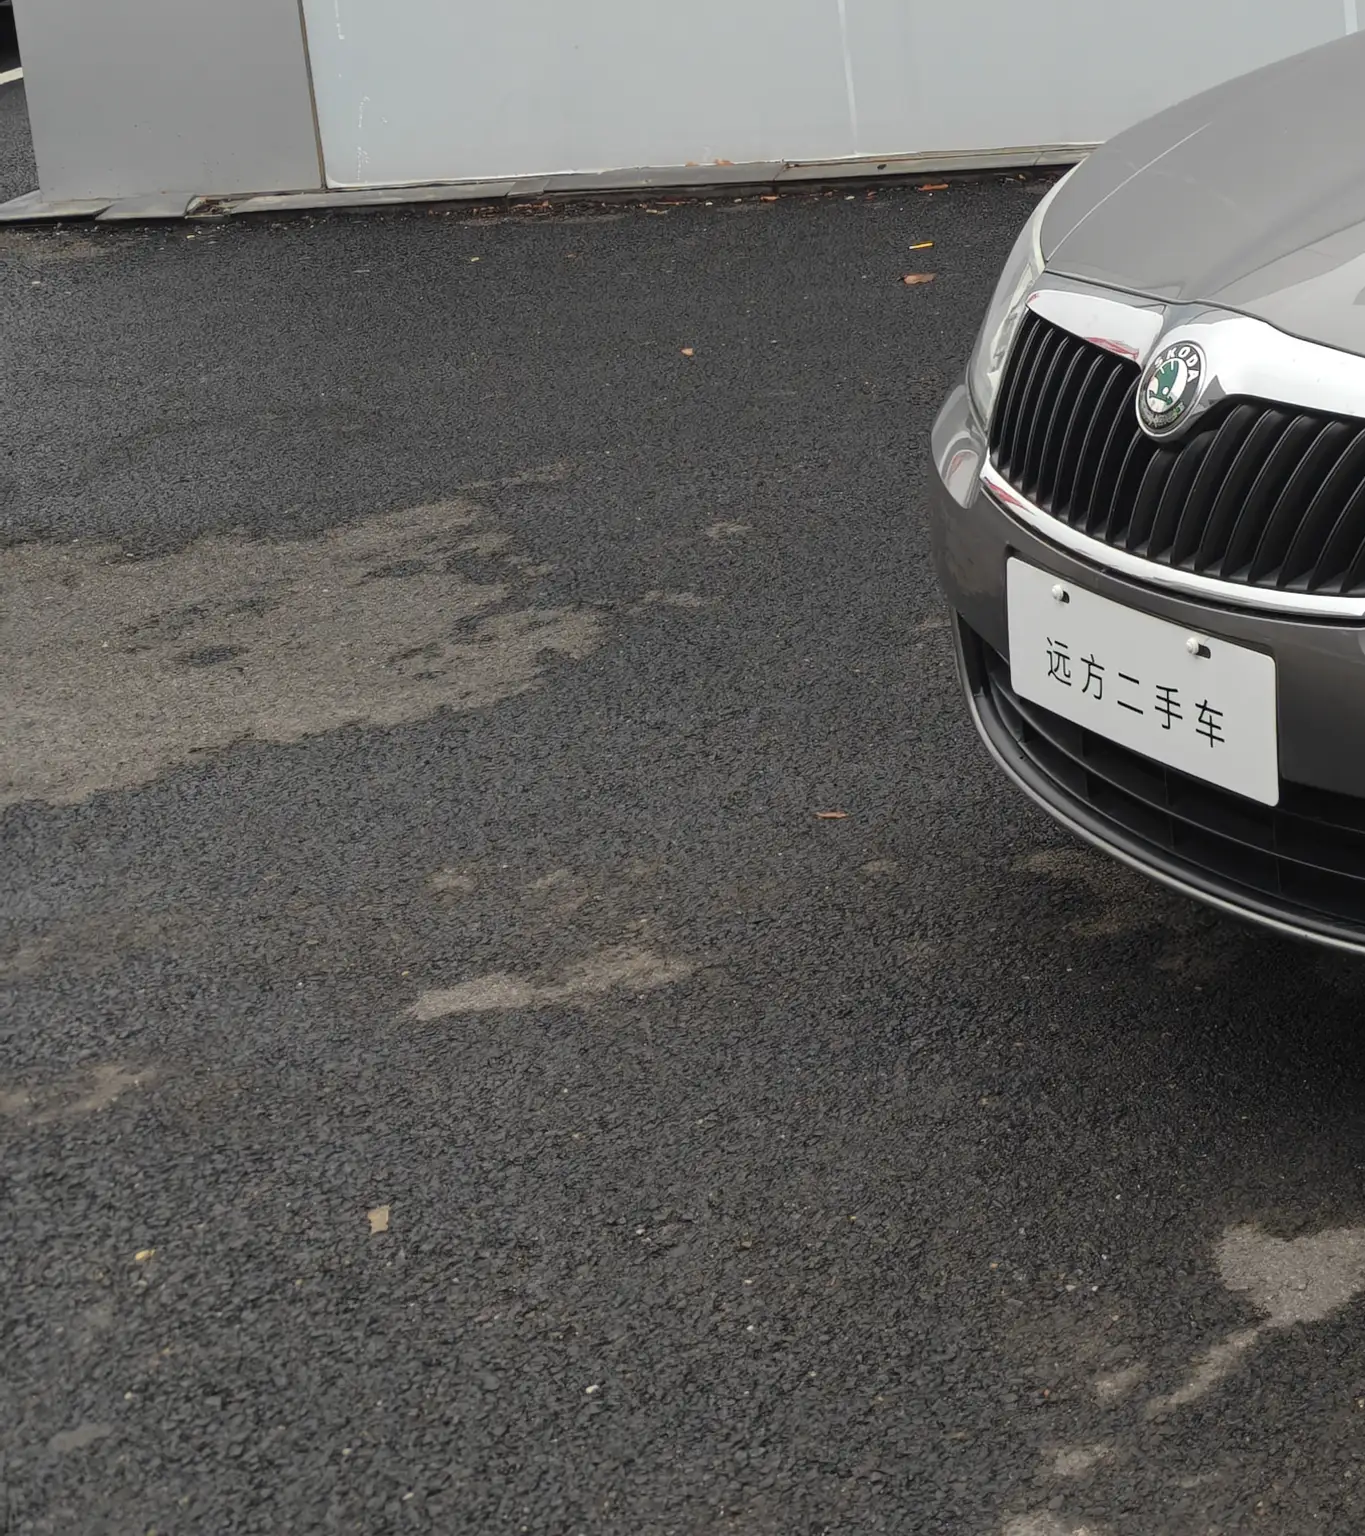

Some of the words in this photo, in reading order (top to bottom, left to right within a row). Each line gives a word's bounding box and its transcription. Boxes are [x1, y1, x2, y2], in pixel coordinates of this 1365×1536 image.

[1045, 636, 1226, 749] 远方二手车
